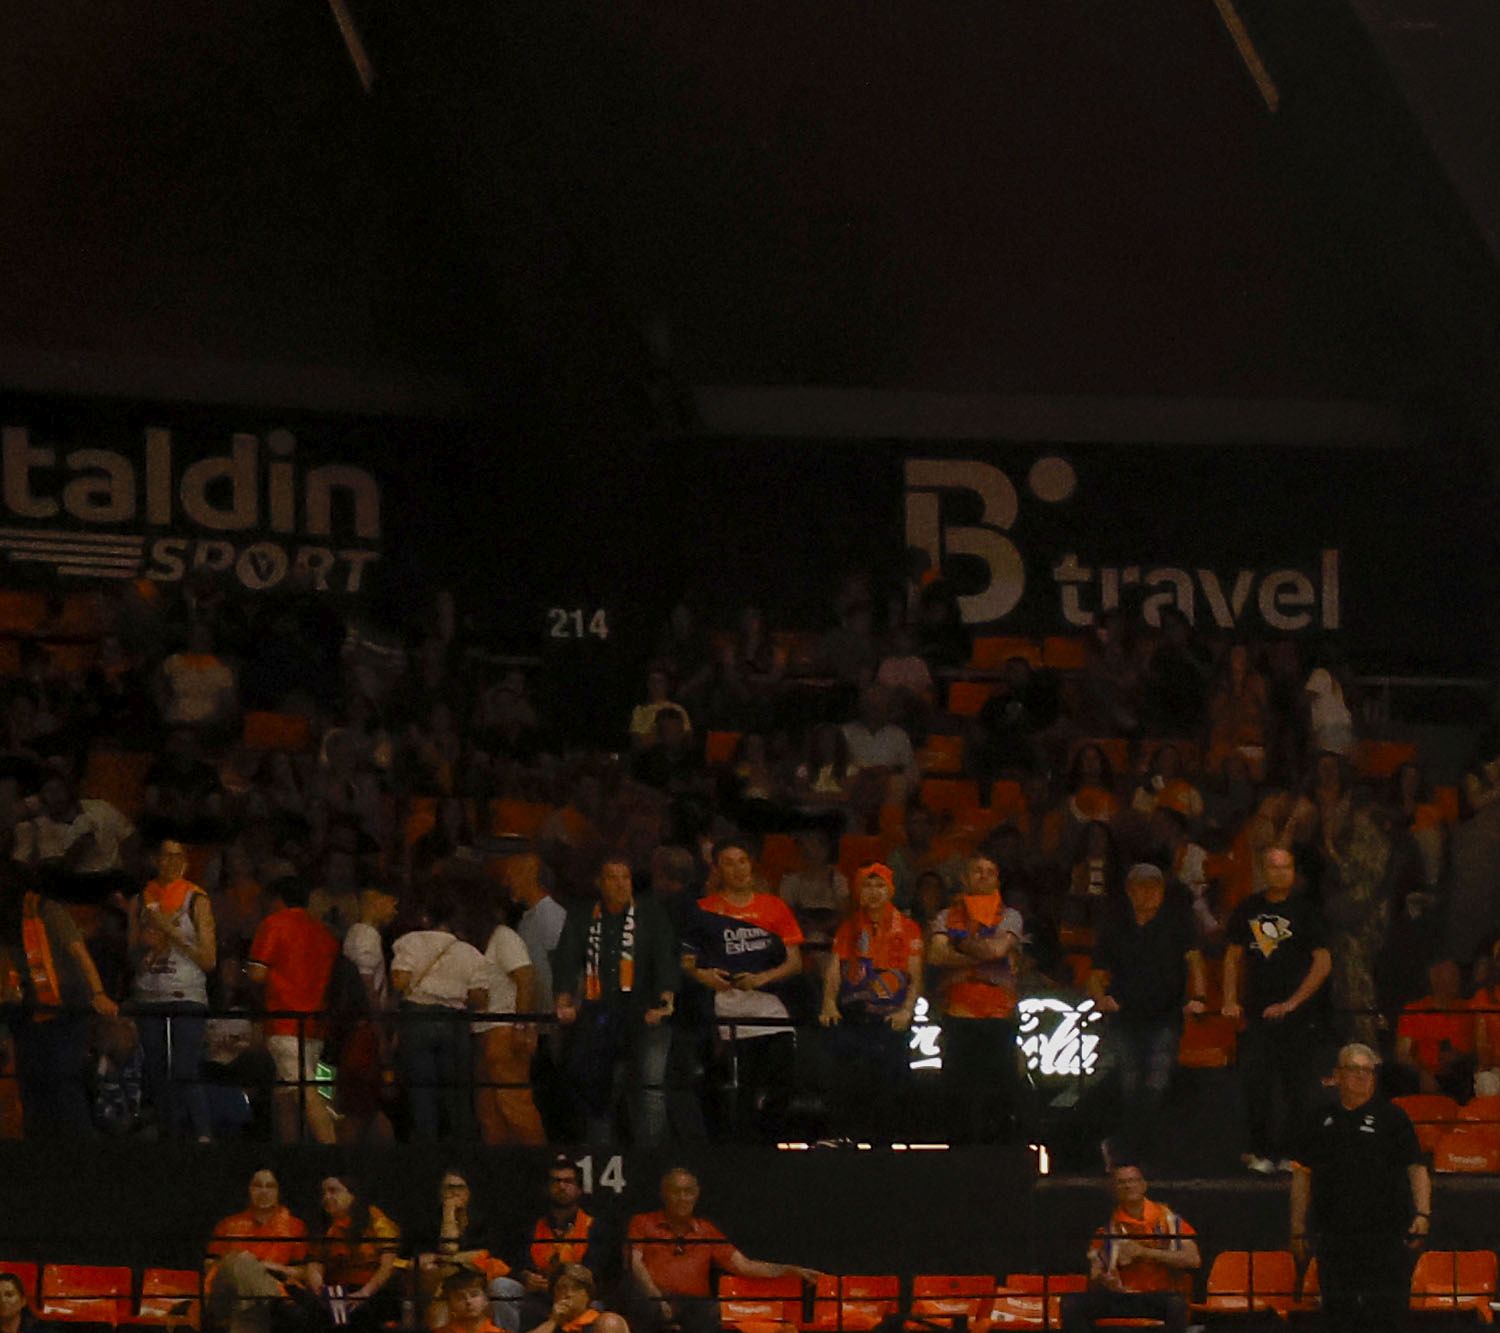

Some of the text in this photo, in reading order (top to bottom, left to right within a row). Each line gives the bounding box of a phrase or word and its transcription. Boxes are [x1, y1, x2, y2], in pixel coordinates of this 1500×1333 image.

[3, 427, 382, 538] taldin
[1053, 549, 1341, 630] travel
[548, 609, 608, 640] 214
[576, 1155, 626, 1194] 14
